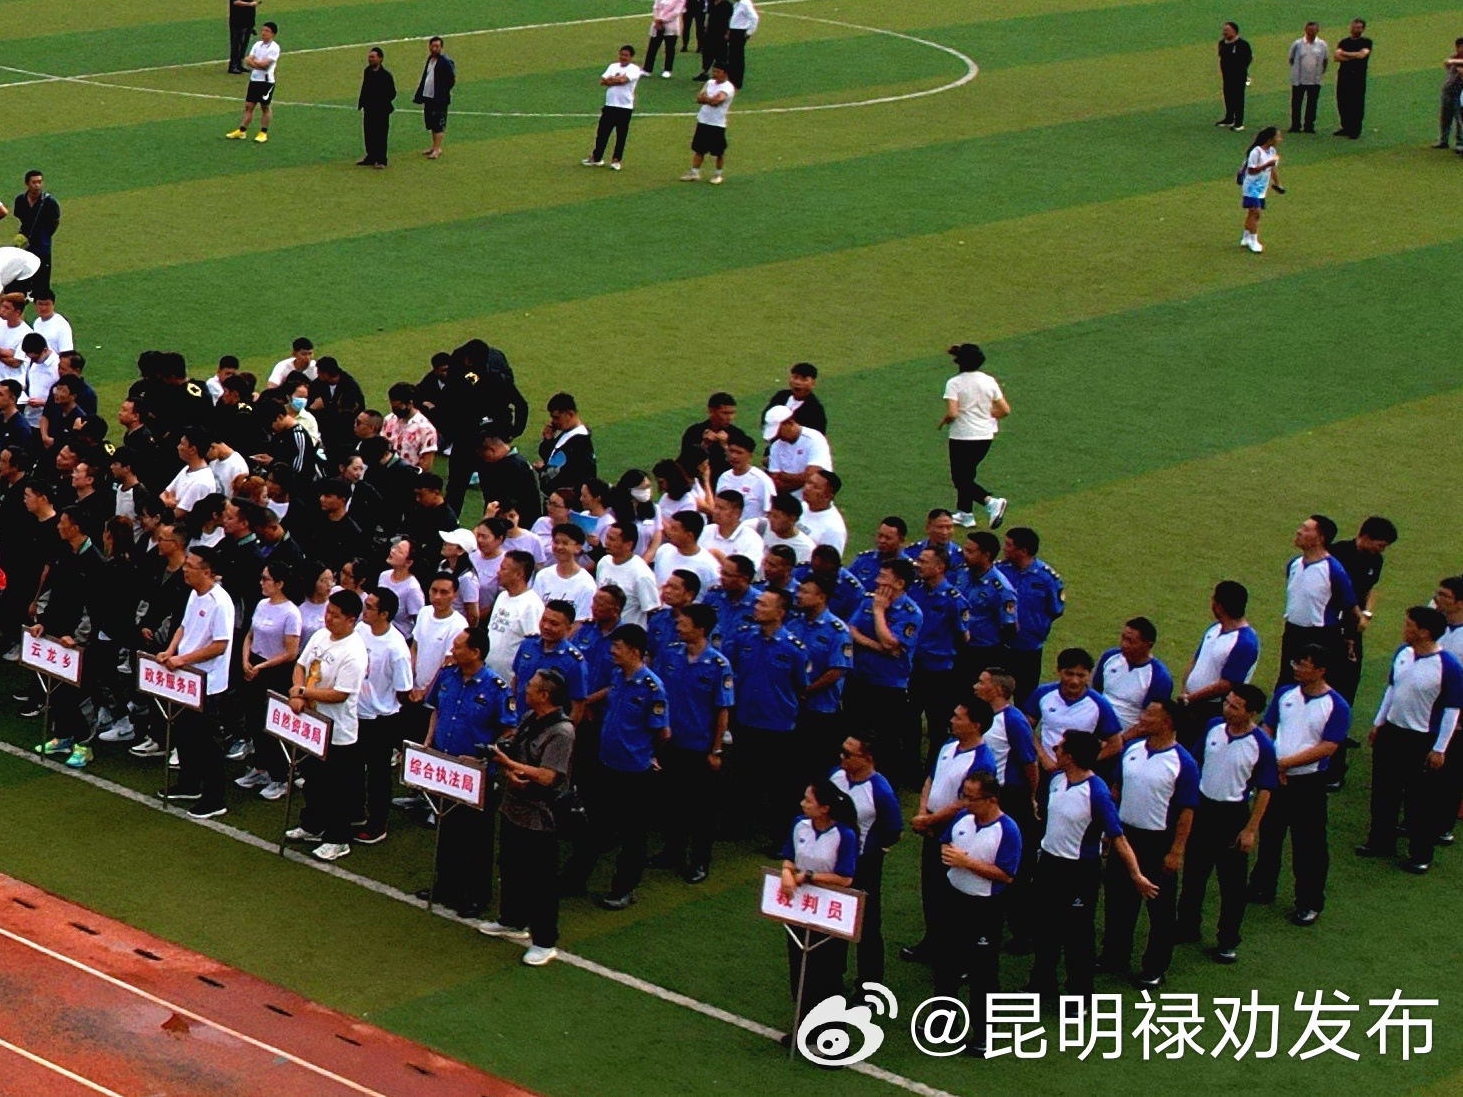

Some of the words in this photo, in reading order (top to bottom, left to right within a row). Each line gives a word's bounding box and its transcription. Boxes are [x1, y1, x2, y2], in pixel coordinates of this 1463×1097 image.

[30, 641, 72, 669] 云龙乡
[144, 666, 198, 697] 政务服务局
[272, 708, 321, 745] 自然资源局
[409, 757, 474, 793] 综合执法局
[776, 888, 844, 921] 裁判员
